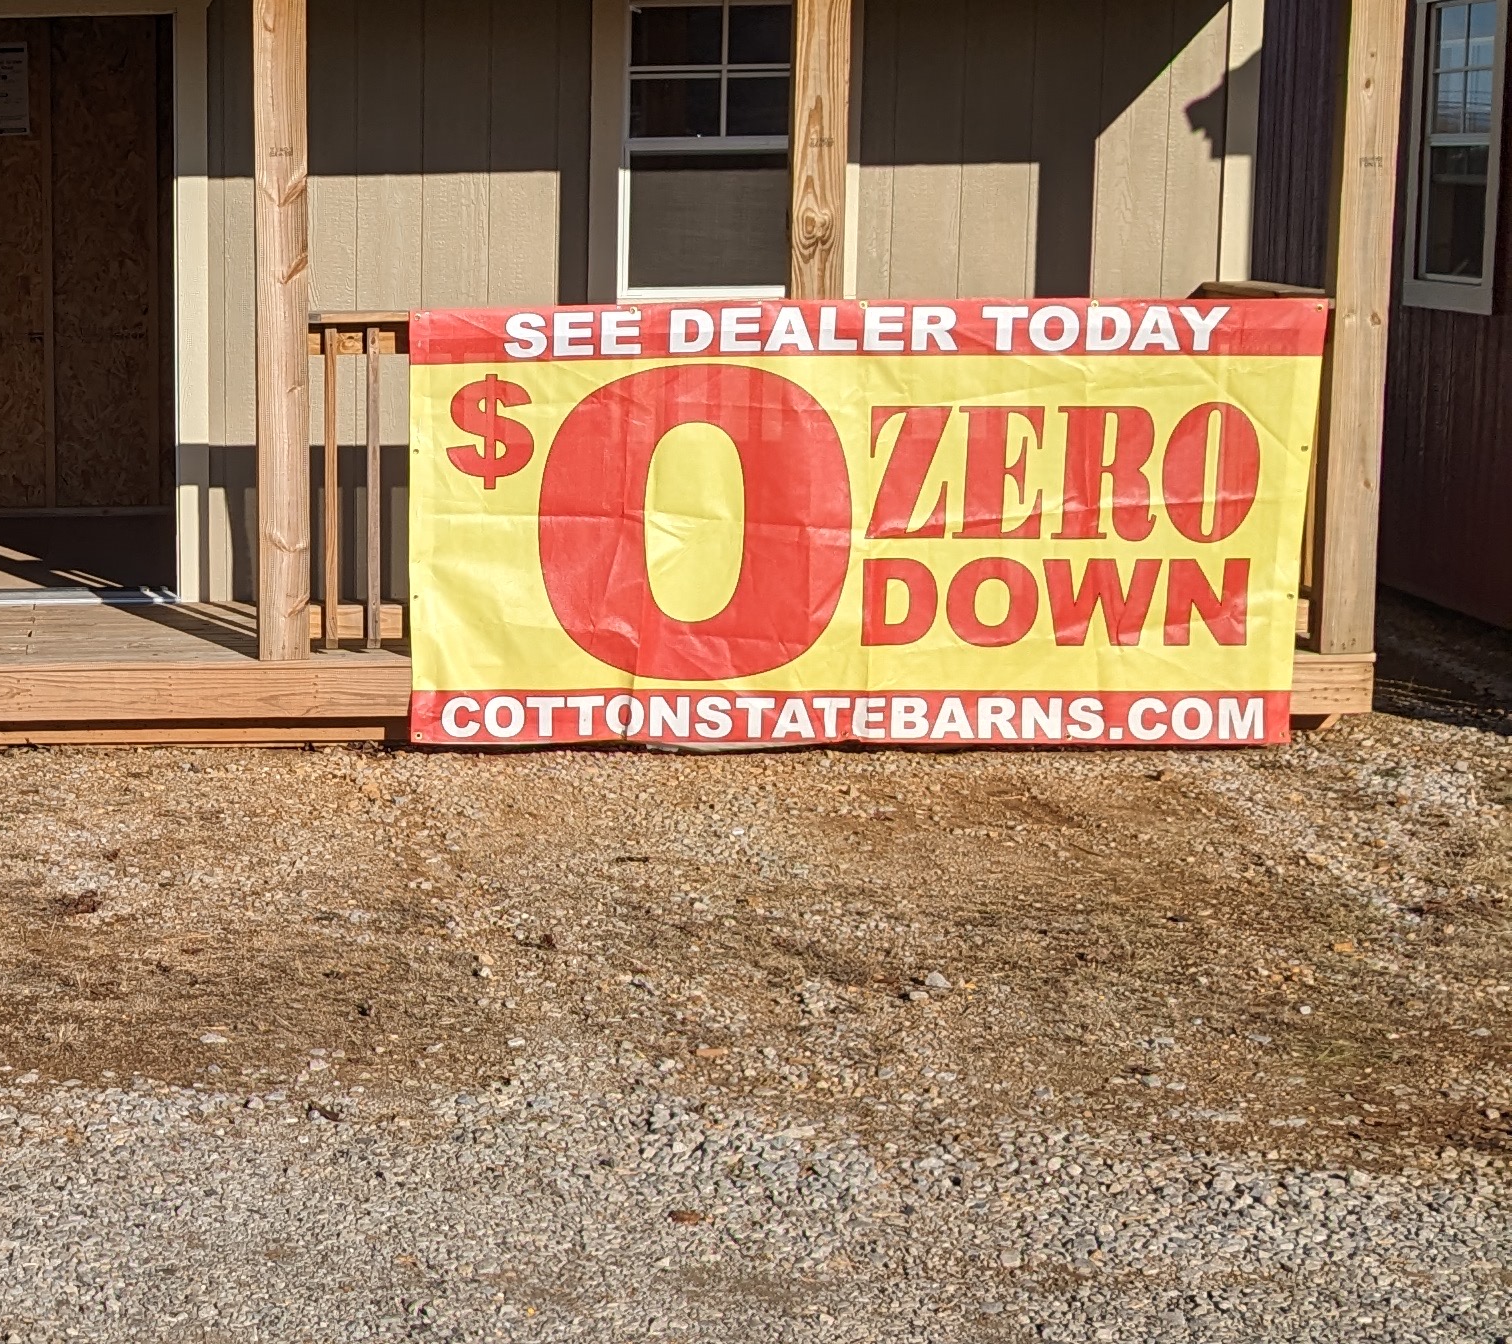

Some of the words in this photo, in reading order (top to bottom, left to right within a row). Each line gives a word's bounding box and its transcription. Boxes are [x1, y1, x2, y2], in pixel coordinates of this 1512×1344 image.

[502, 310, 643, 359] SEE
[669, 306, 959, 355] DEALER
[981, 305, 1231, 353] TODAY
[864, 401, 1261, 544] ZERO
[860, 556, 1251, 647] DOWN
[440, 693, 1266, 740] COTTONSTATEBARNS.COM
